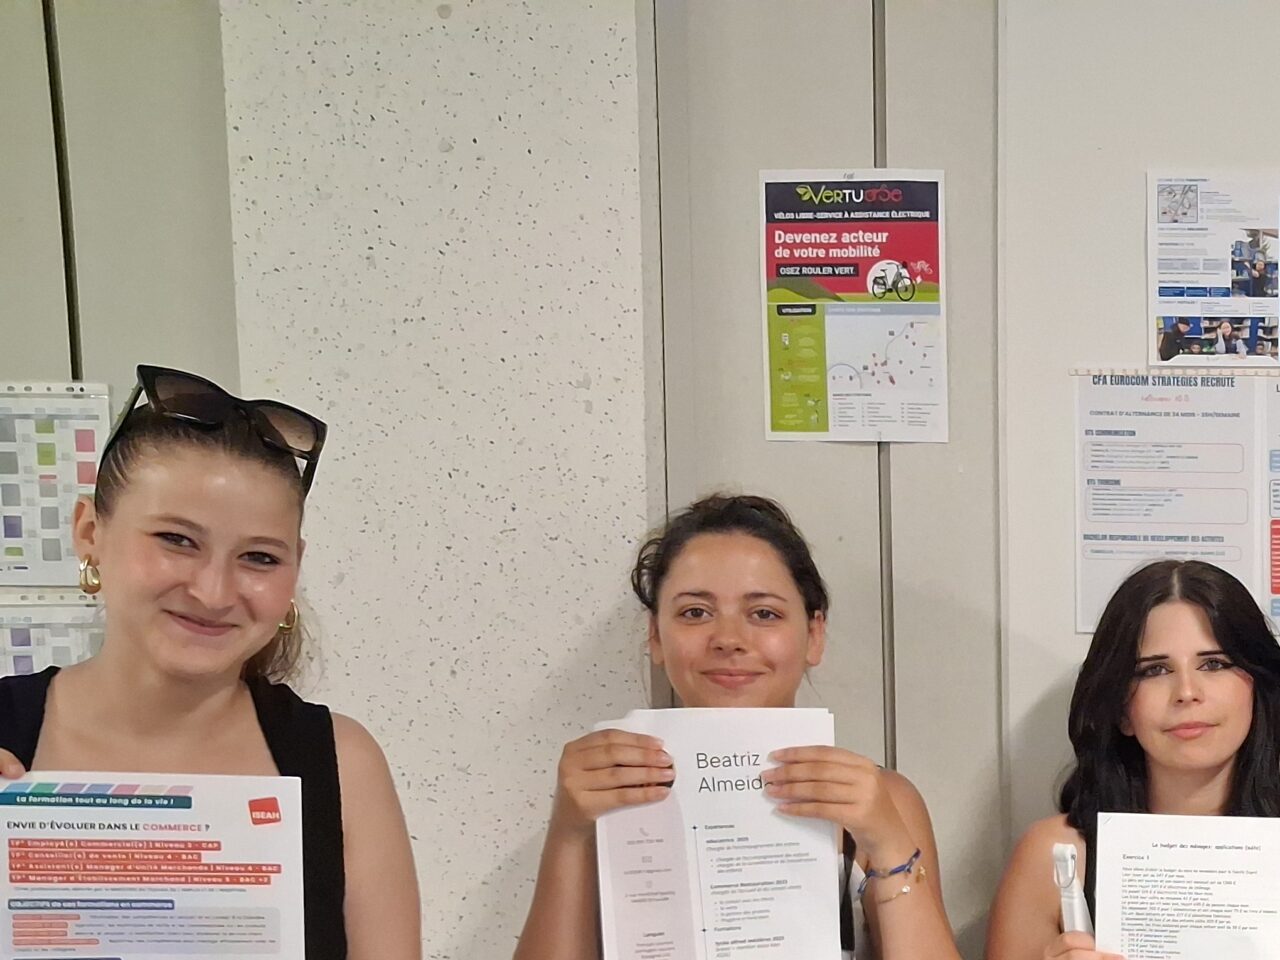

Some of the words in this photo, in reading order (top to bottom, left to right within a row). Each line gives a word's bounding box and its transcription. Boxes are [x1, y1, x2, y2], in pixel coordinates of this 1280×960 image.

[775, 230, 837, 243] Devenez
[841, 230, 888, 243] acteur
[775, 246, 790, 257] de
[793, 247, 825, 257] votre
[829, 245, 880, 257] mobilité
[802, 266, 832, 274] ROULER
[1092, 375, 1107, 385] CFA
[1110, 375, 1149, 386] EUROCOM
[1152, 376, 1198, 387] STRATEGIES
[1201, 376, 1235, 387] RECRUTE
[696, 752, 760, 768] Beatriz
[699, 773, 773, 792] Almeid
[110, 797, 128, 805] long
[7, 821, 36, 829] ENVIE
[40, 820, 96, 830] D'ÉVOLUER
